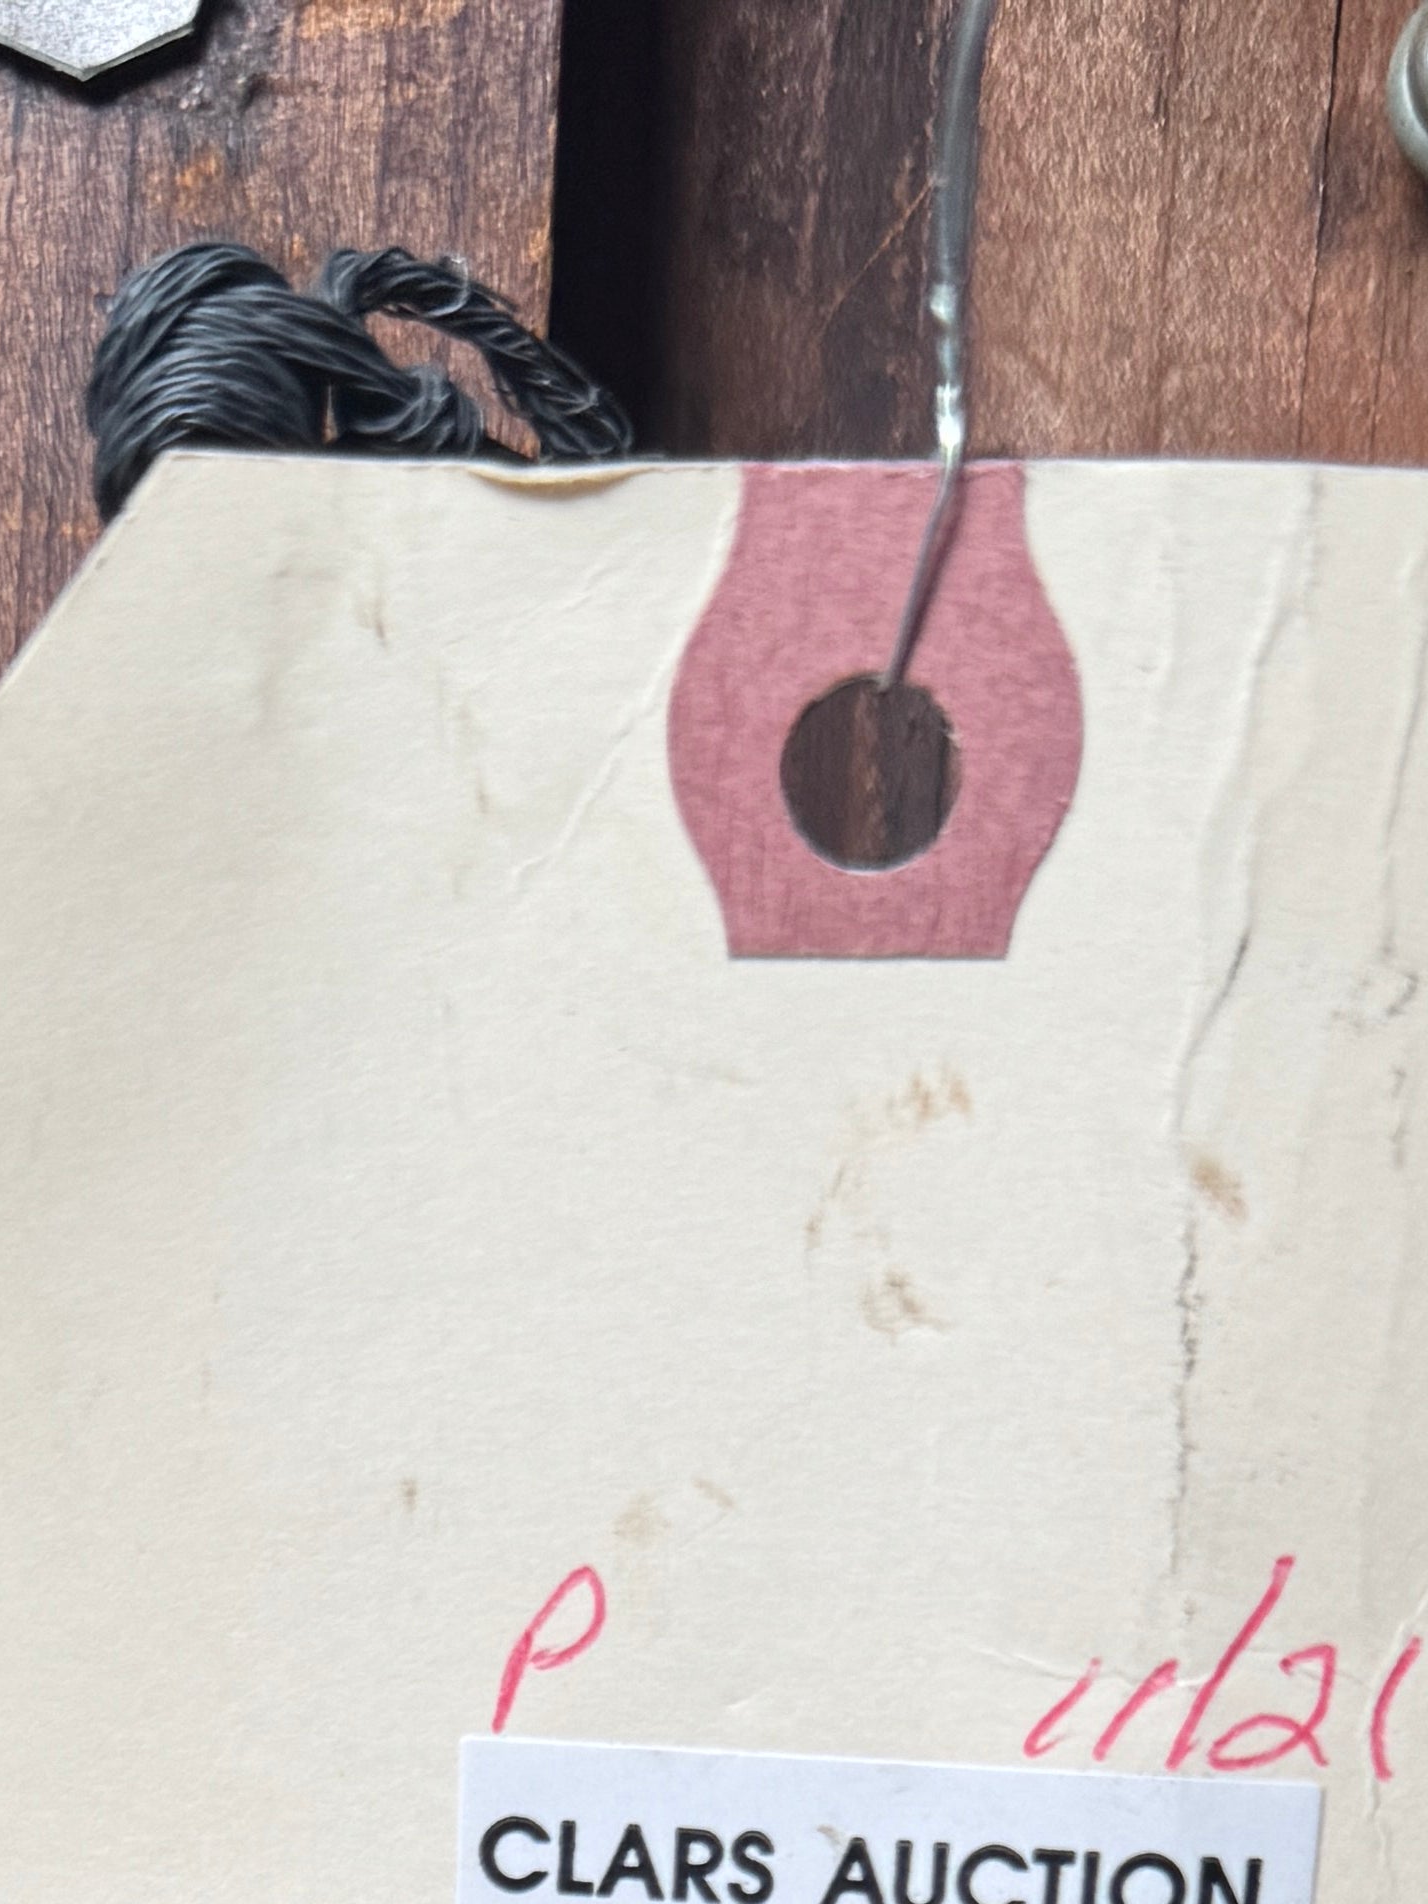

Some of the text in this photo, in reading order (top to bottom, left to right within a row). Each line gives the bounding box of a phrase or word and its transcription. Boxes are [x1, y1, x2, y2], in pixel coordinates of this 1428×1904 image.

[492, 1566, 605, 1732] P
[1024, 1556, 1420, 1780] 11/21
[481, 1816, 773, 1904] CLARS
